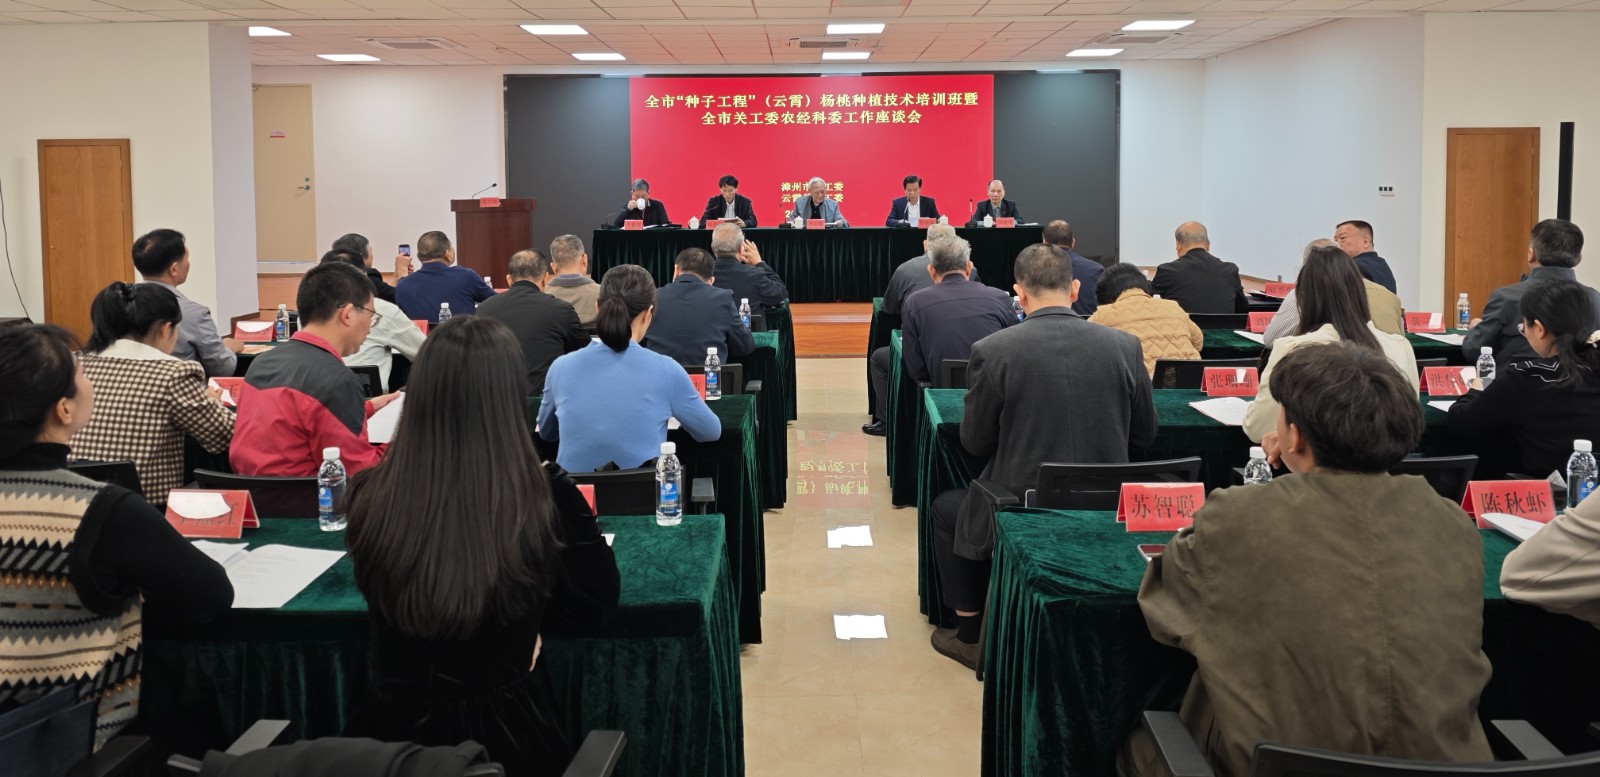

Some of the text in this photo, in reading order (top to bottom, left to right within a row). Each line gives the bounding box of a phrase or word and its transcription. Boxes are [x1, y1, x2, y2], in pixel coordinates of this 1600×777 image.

[701, 109, 922, 126] 全市关工委农经科委工作座谈会
[781, 181, 844, 192] 漳州市工委
[1128, 493, 1195, 519] 苏智聪
[1480, 491, 1547, 515] 陈秋虾
